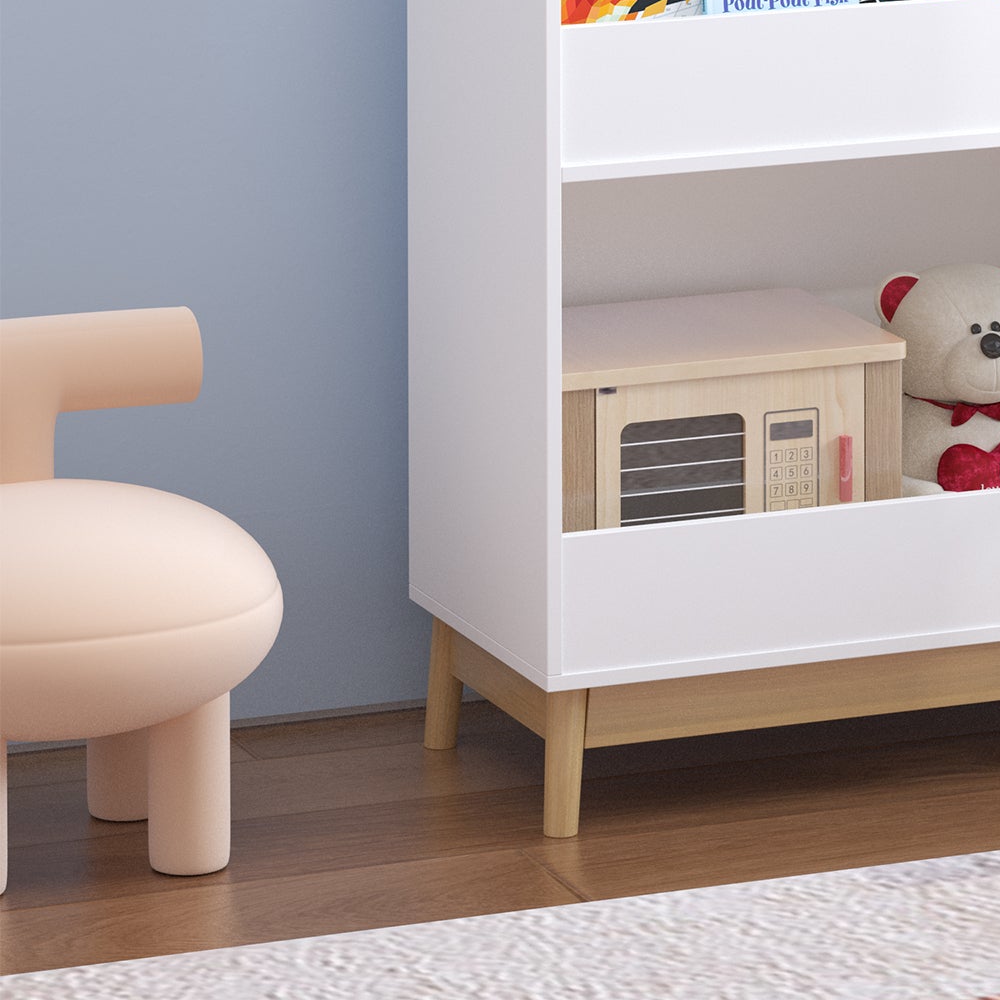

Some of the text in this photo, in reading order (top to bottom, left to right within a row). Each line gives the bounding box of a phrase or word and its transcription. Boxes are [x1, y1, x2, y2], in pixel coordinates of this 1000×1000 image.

[774, 449, 809, 461] 1 2 3
[773, 467, 809, 478] 4 5 6
[773, 483, 809, 495] 7 8 9
